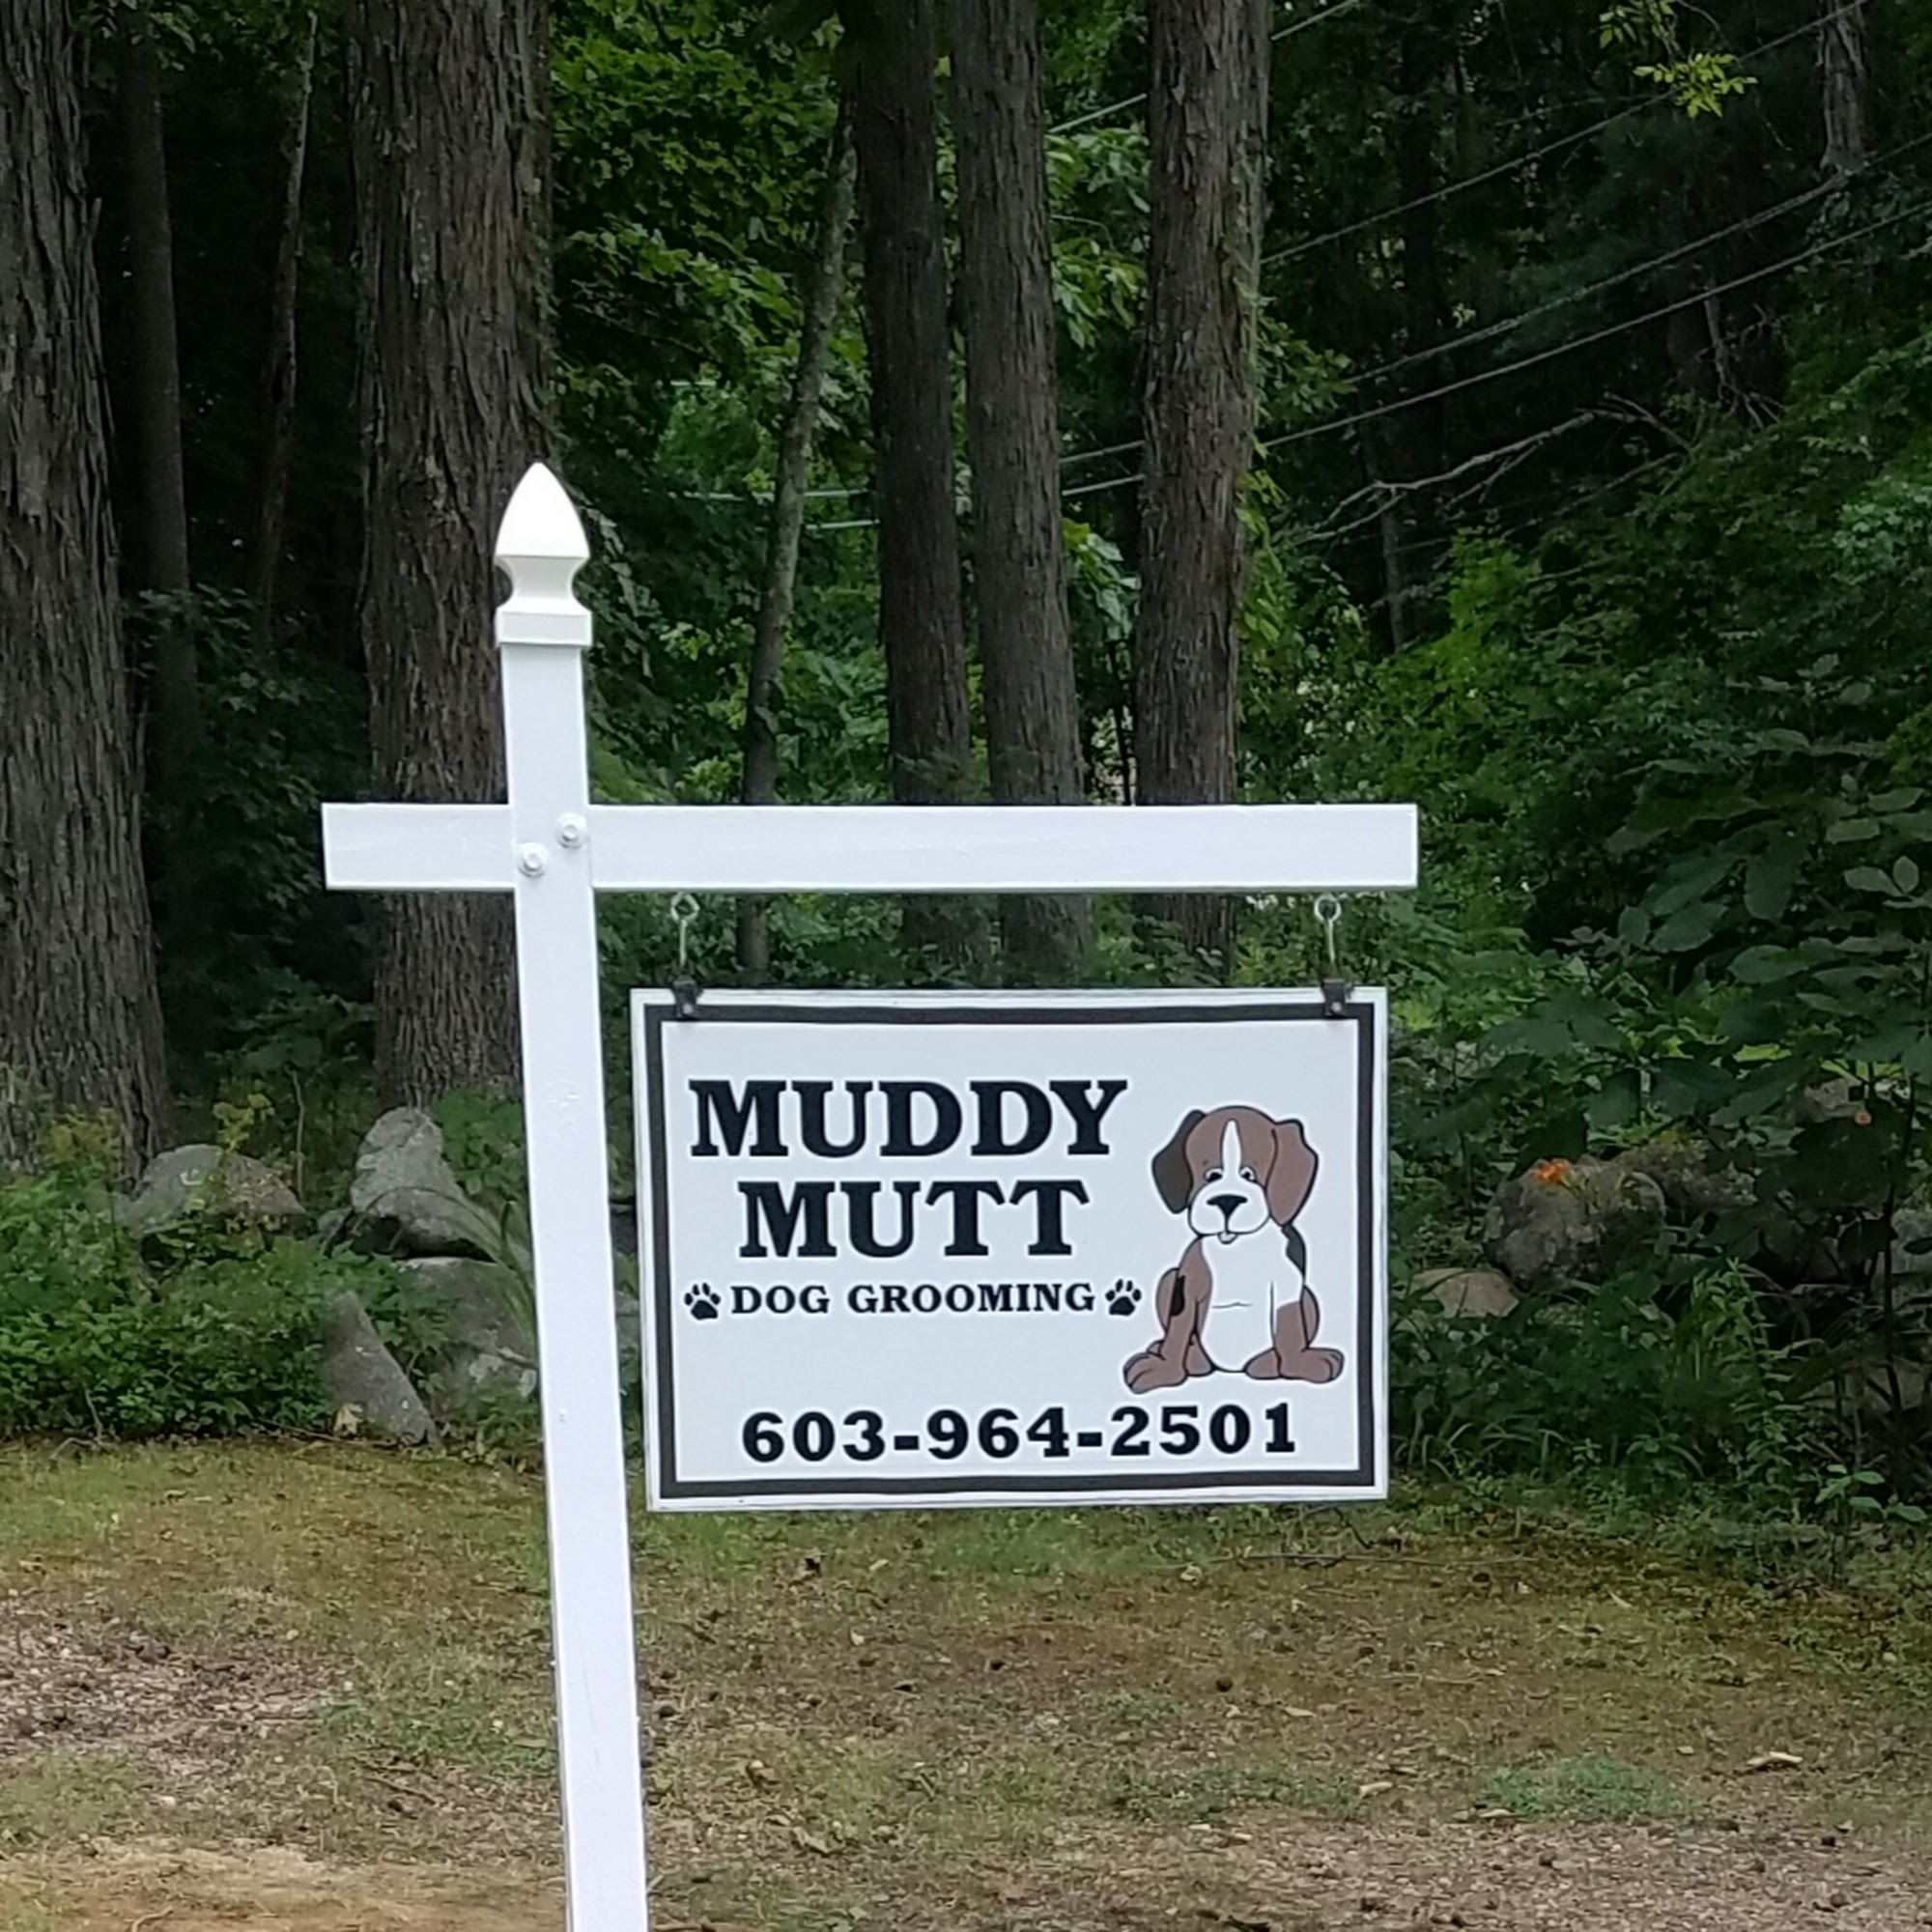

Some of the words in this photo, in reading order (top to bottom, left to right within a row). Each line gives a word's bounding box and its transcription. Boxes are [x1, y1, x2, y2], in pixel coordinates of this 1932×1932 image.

[688, 1079, 1128, 1158] MUDDY
[737, 1179, 1090, 1259] MUTT
[730, 1285, 830, 1314] DOG
[847, 1283, 1095, 1314] GROOMING
[741, 1402, 1296, 1463] 603-964-2501
